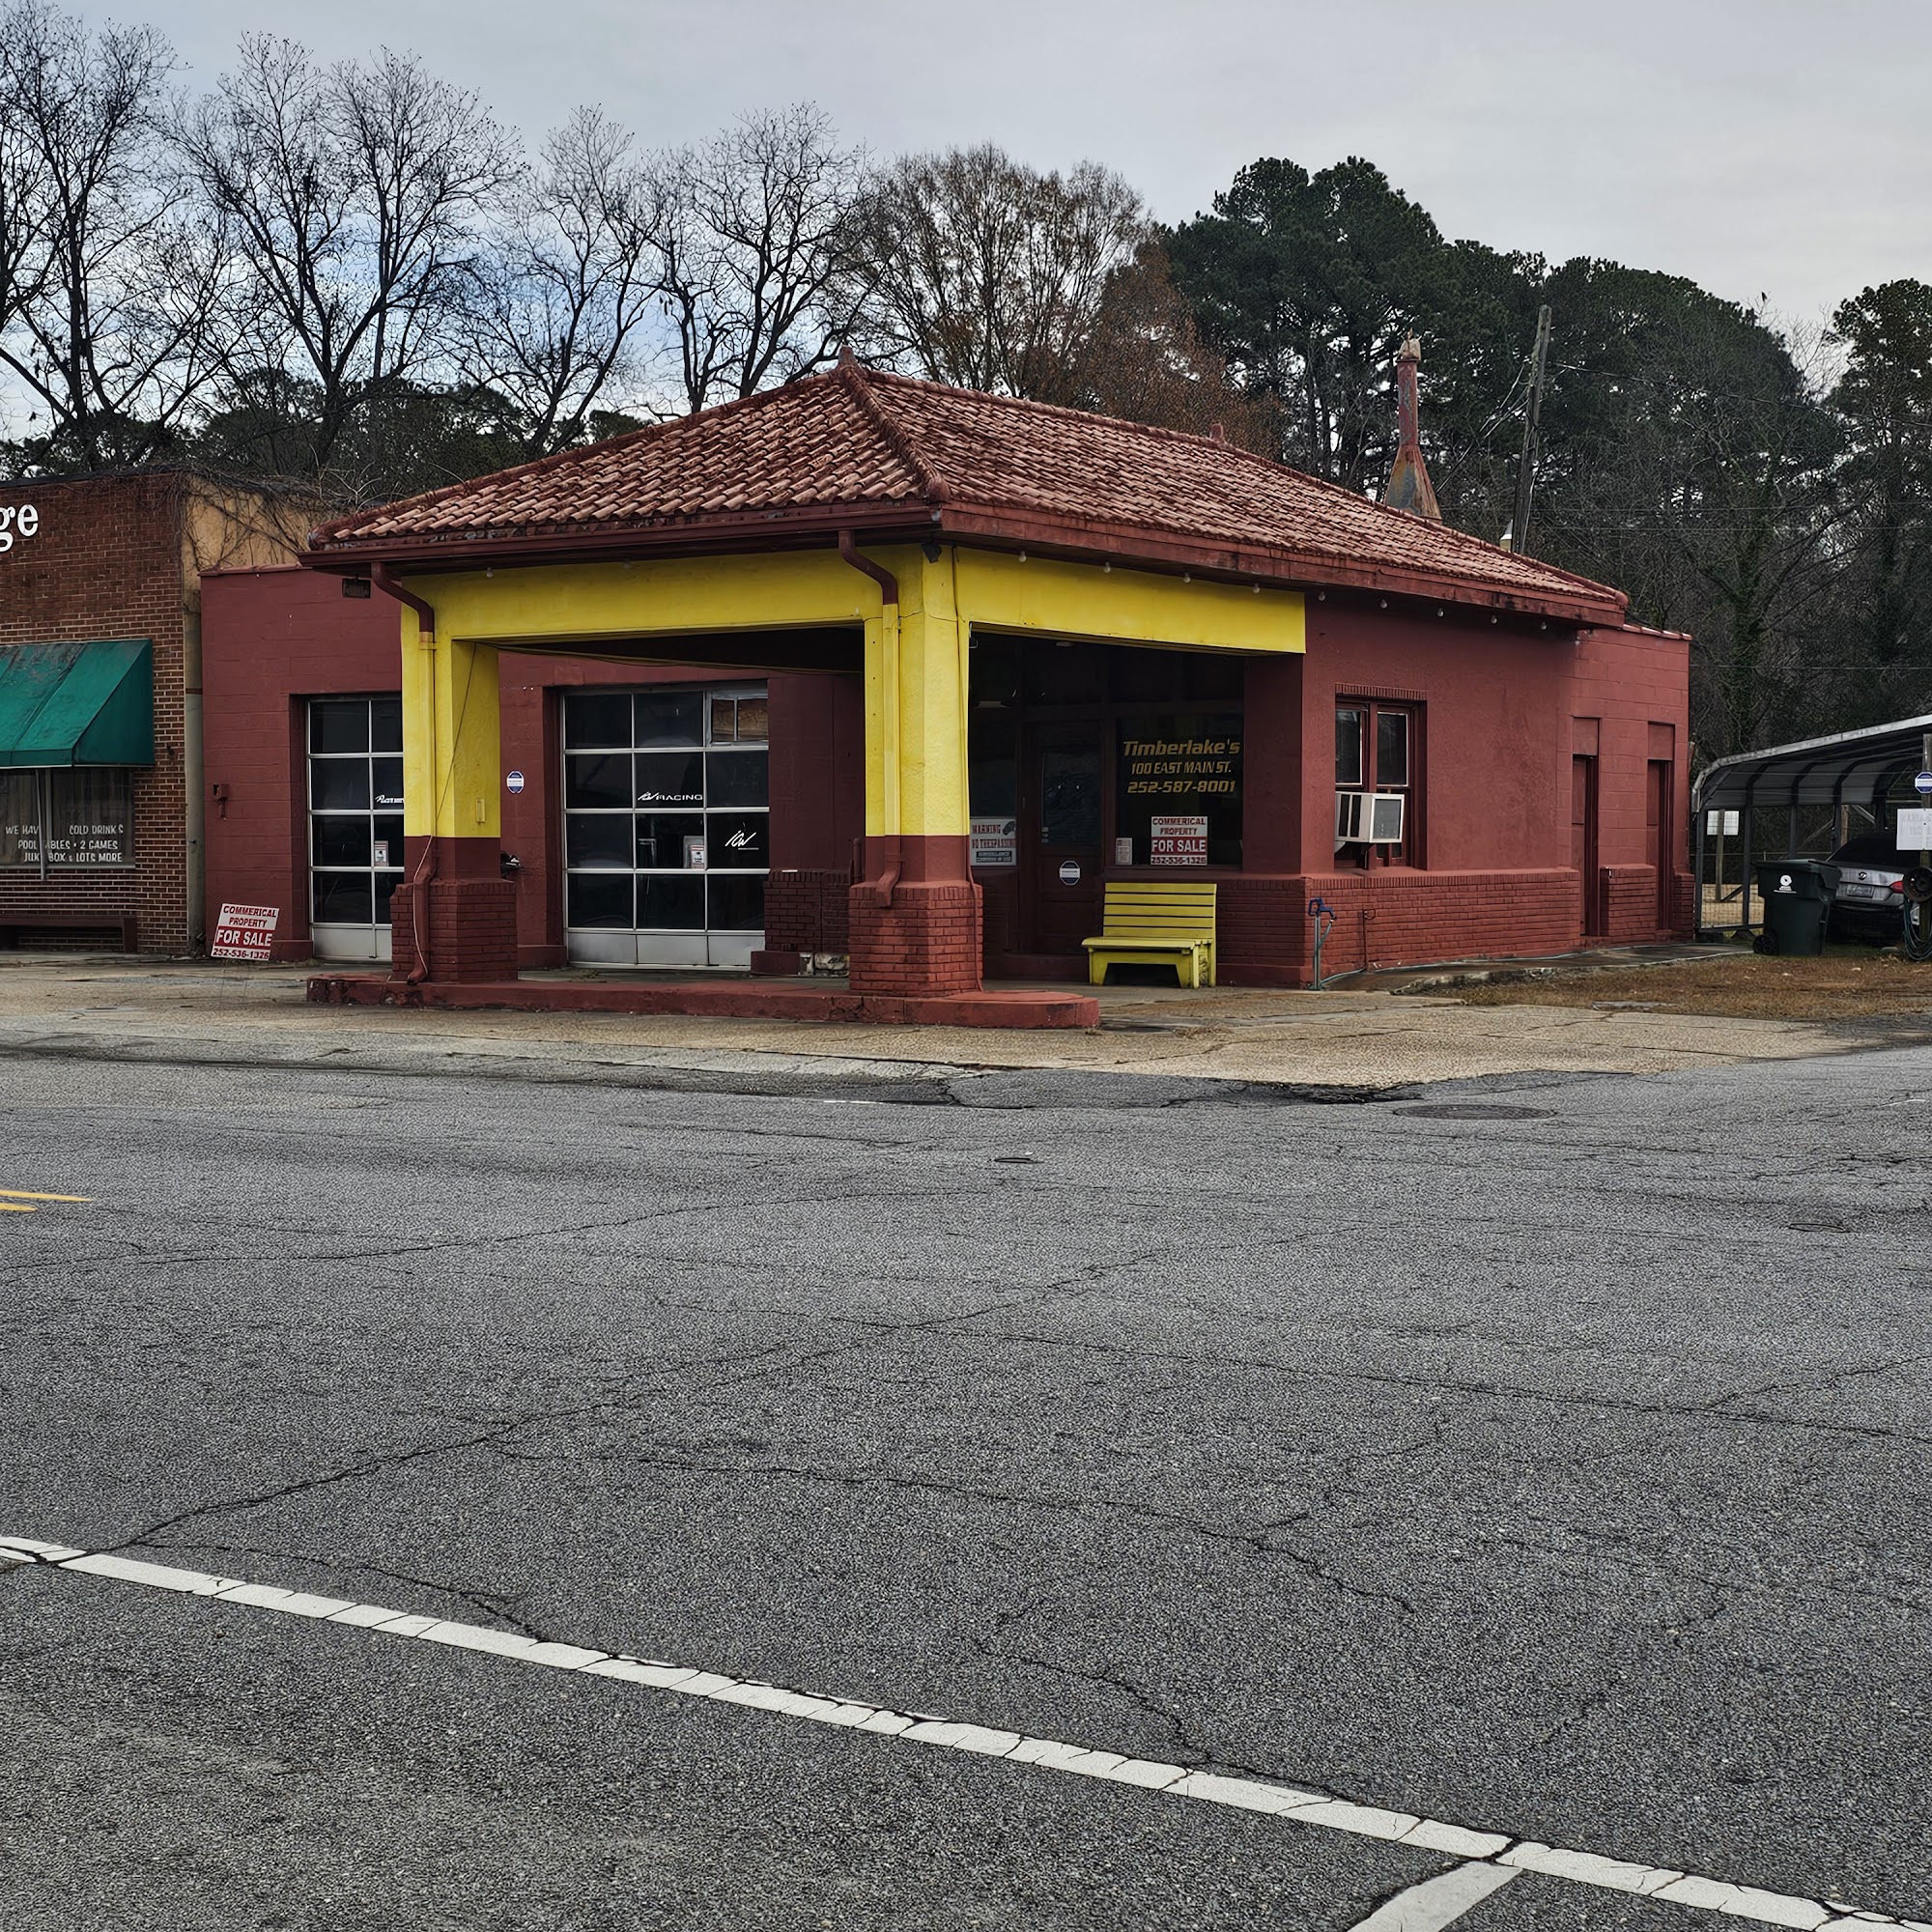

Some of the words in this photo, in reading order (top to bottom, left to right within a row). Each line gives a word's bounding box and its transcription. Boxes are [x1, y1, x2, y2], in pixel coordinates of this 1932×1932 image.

[1123, 739, 1240, 755] Timberlake's
[1131, 762, 1152, 775] 100
[1153, 762, 1182, 774] EAST
[1183, 761, 1215, 774] MAIN
[1216, 761, 1232, 773] ST.
[1127, 781, 1236, 793] 252-587-8001
[6, 826, 18, 835] WE
[22, 825, 40, 835] HAV
[69, 825, 89, 835] COLD
[18, 839, 37, 849] POOL
[80, 840, 85, 849] 2
[89, 839, 118, 849] GAMES
[1151, 839, 1174, 852] FOR
[1177, 839, 1207, 852] SALE
[24, 852, 40, 862] JUK
[48, 852, 66, 862] BOX
[76, 852, 96, 862] LOTS
[99, 852, 123, 862] MORE
[229, 918, 268, 927] PROPERTY
[215, 929, 241, 944] FOR
[242, 931, 272, 947] SALE
